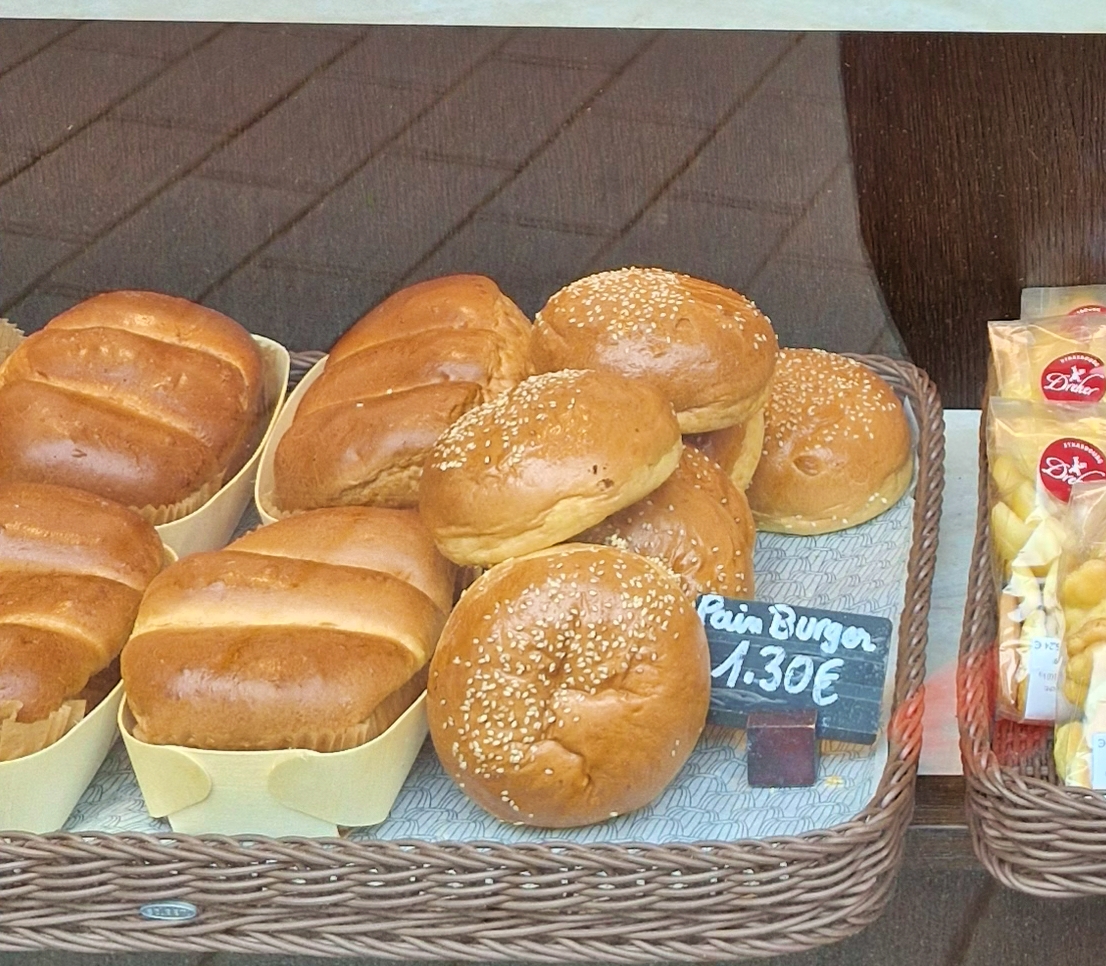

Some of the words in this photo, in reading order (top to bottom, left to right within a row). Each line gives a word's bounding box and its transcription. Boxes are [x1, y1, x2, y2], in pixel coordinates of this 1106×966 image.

[1043, 372, 1105, 396] Dreher
[698, 594, 763, 634] Pain
[769, 604, 876, 653] Burger
[711, 640, 844, 706] 1.30€
[1098, 739, 1106, 748] €
